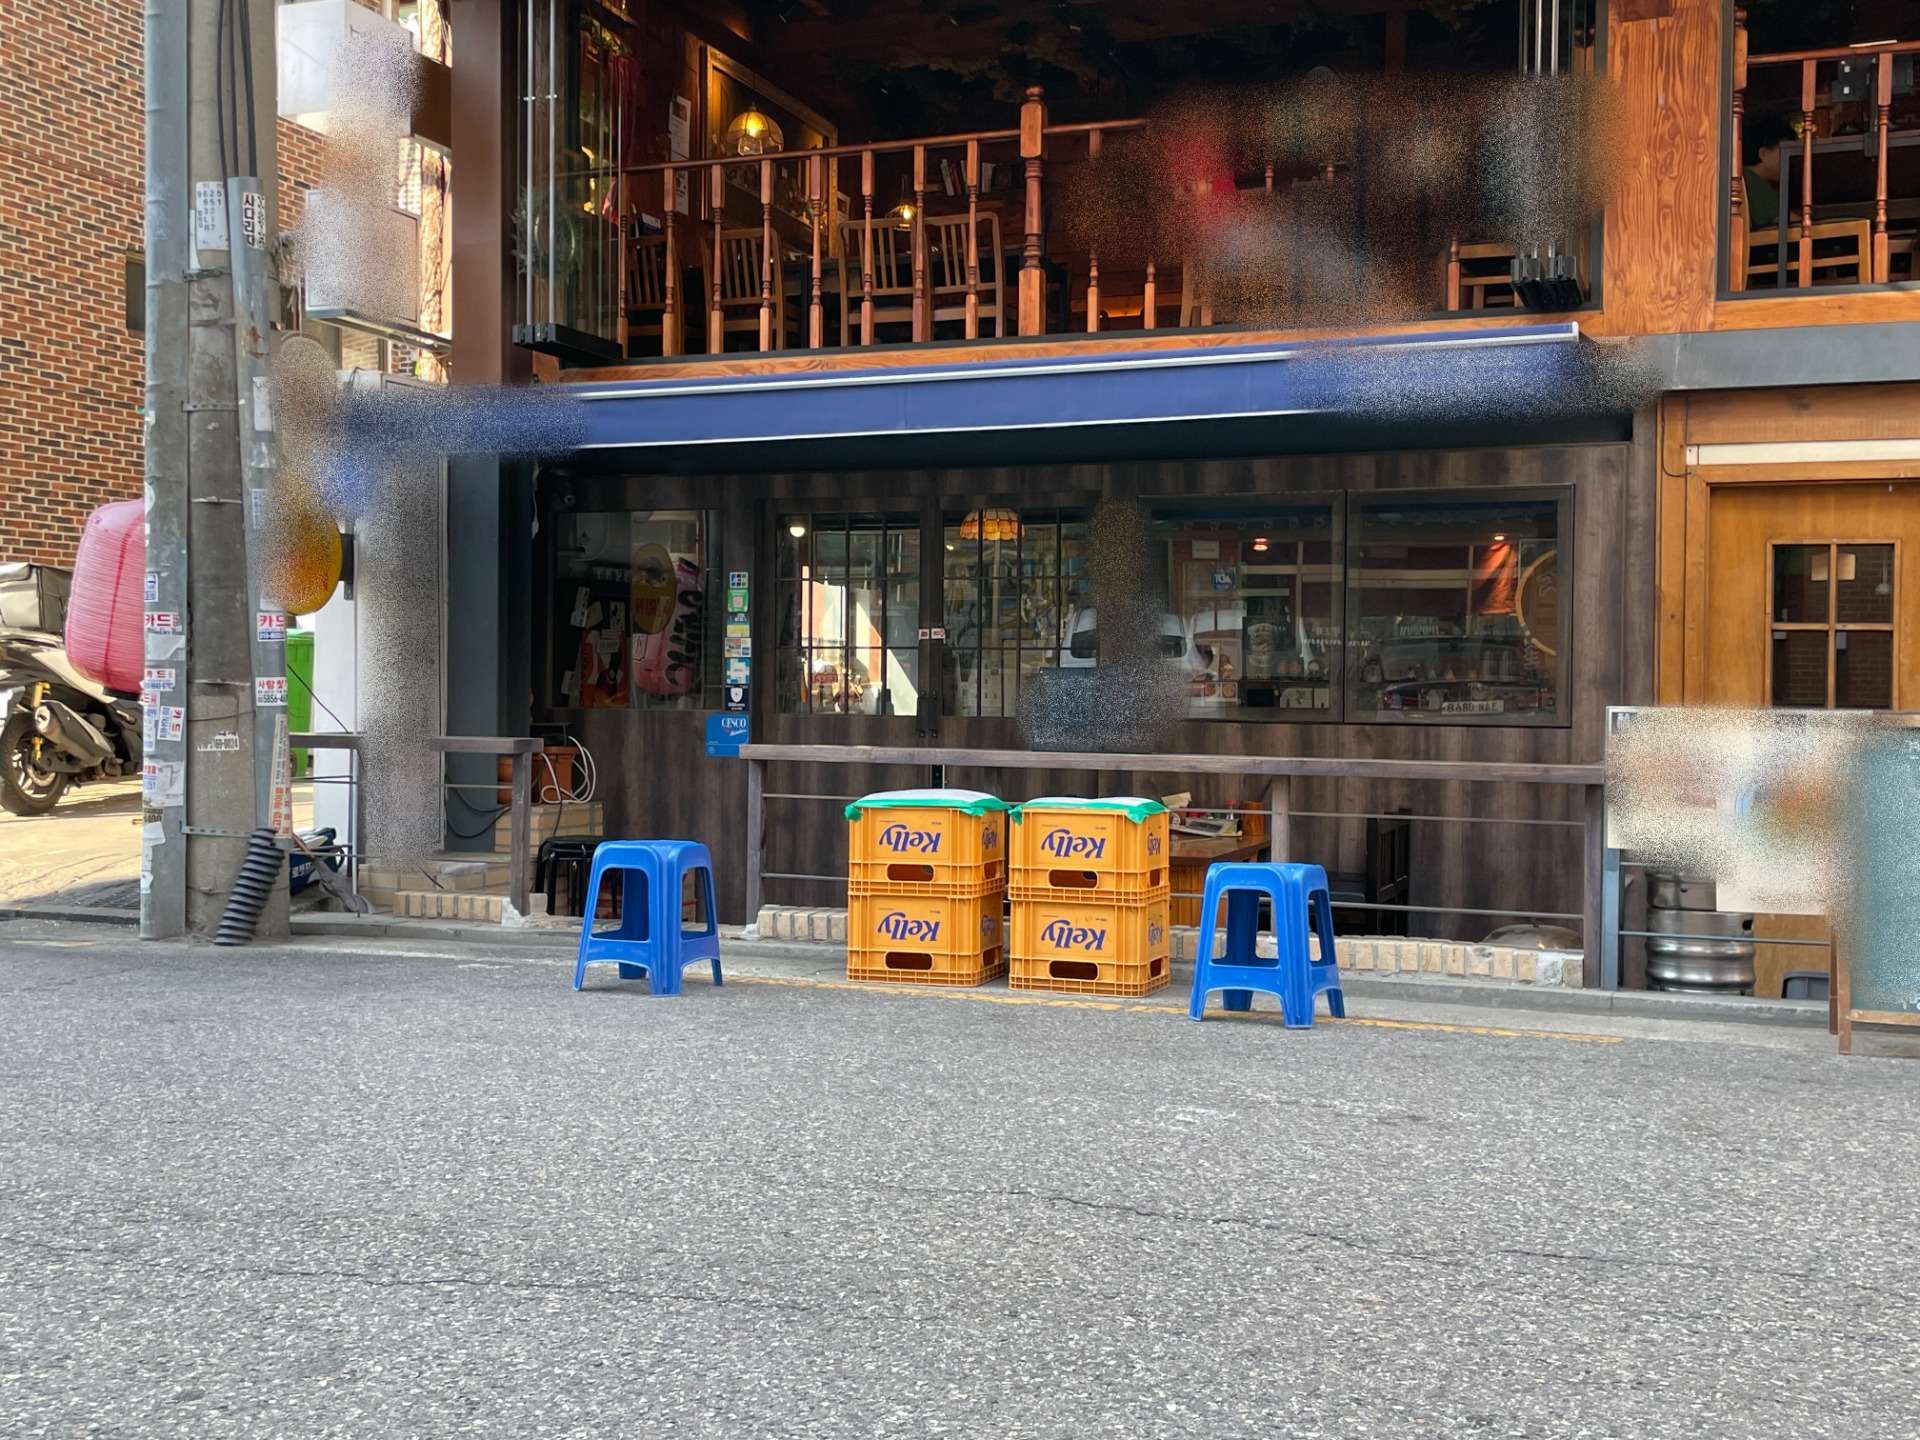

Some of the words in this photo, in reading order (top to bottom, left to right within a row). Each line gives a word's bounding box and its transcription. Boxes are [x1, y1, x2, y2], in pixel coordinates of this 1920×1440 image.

[879, 823, 941, 853] Kelly
[1040, 828, 1106, 859] Kelly
[877, 911, 940, 942] Kelly
[1040, 919, 1107, 951] Kelly
